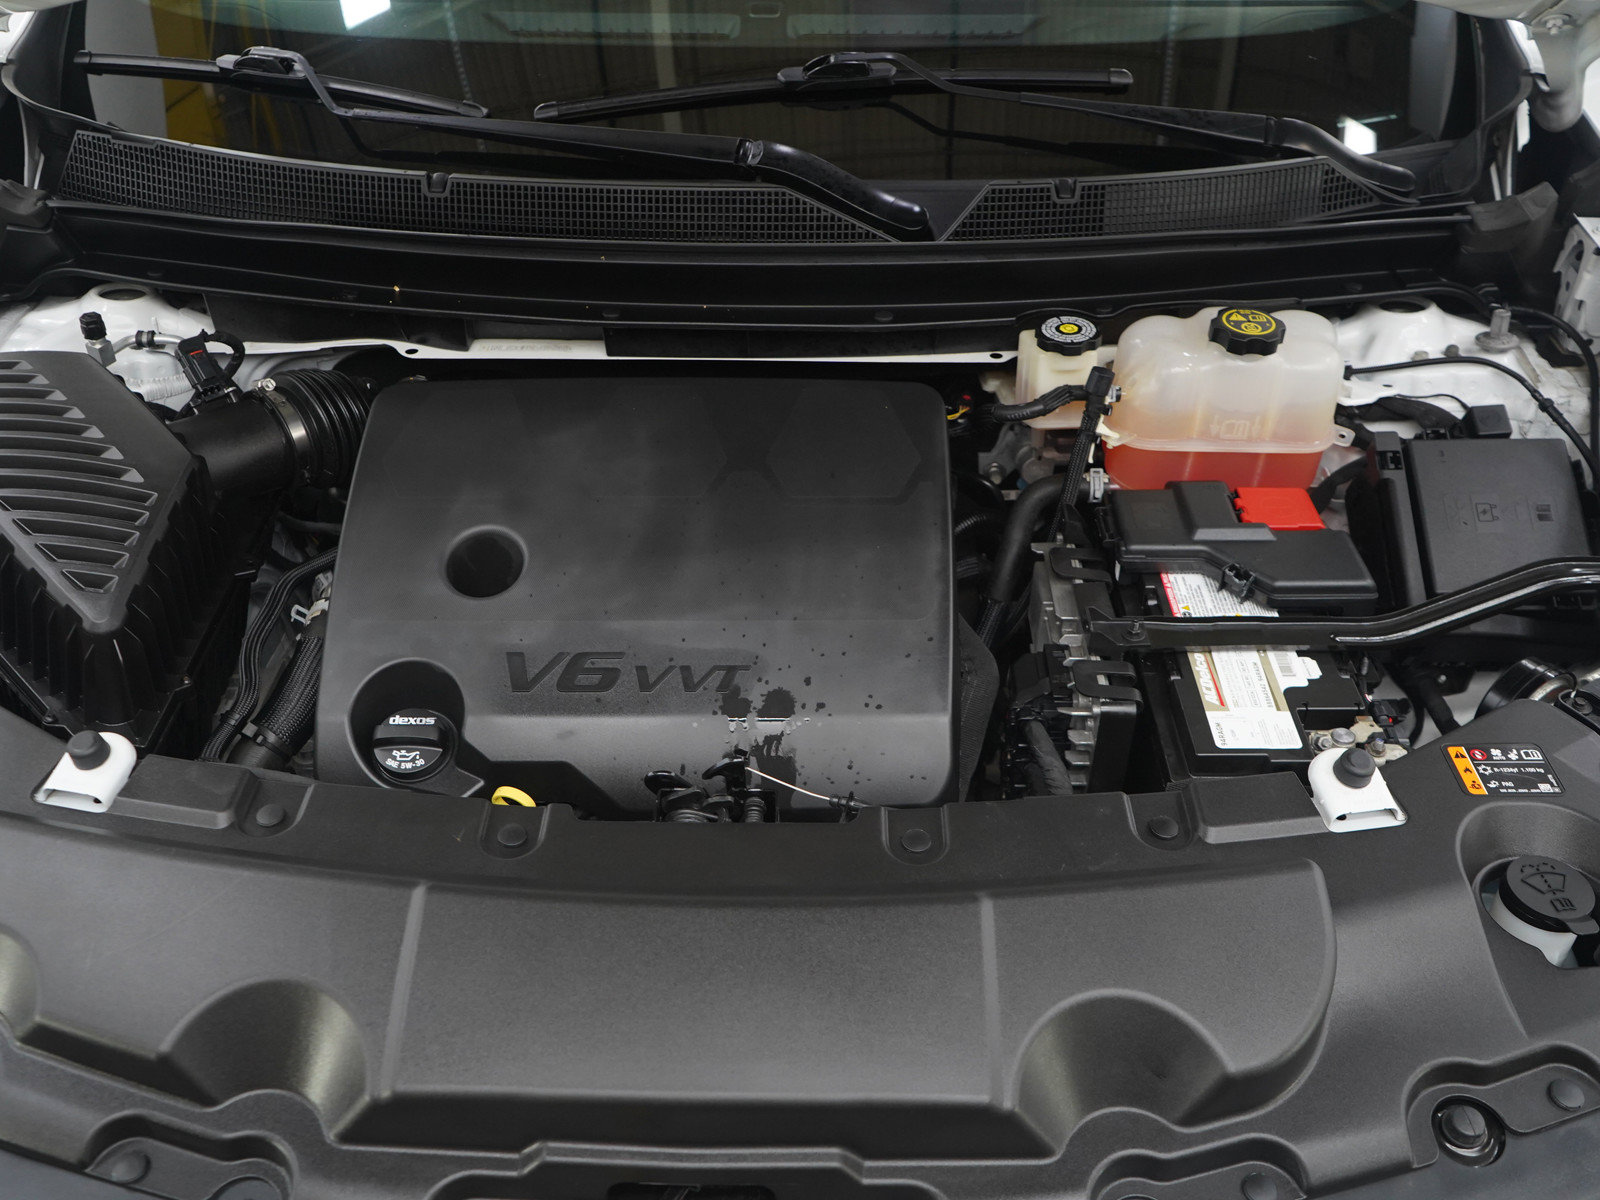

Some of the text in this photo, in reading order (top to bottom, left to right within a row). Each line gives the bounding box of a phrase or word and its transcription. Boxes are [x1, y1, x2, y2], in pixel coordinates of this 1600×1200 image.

[505, 651, 751, 692] V6 VVT
[1193, 652, 1221, 706] ACDelco
[388, 714, 437, 725] dexos
[1215, 722, 1228, 746] 94RAGM
[385, 758, 425, 769] SAE 5W-30
